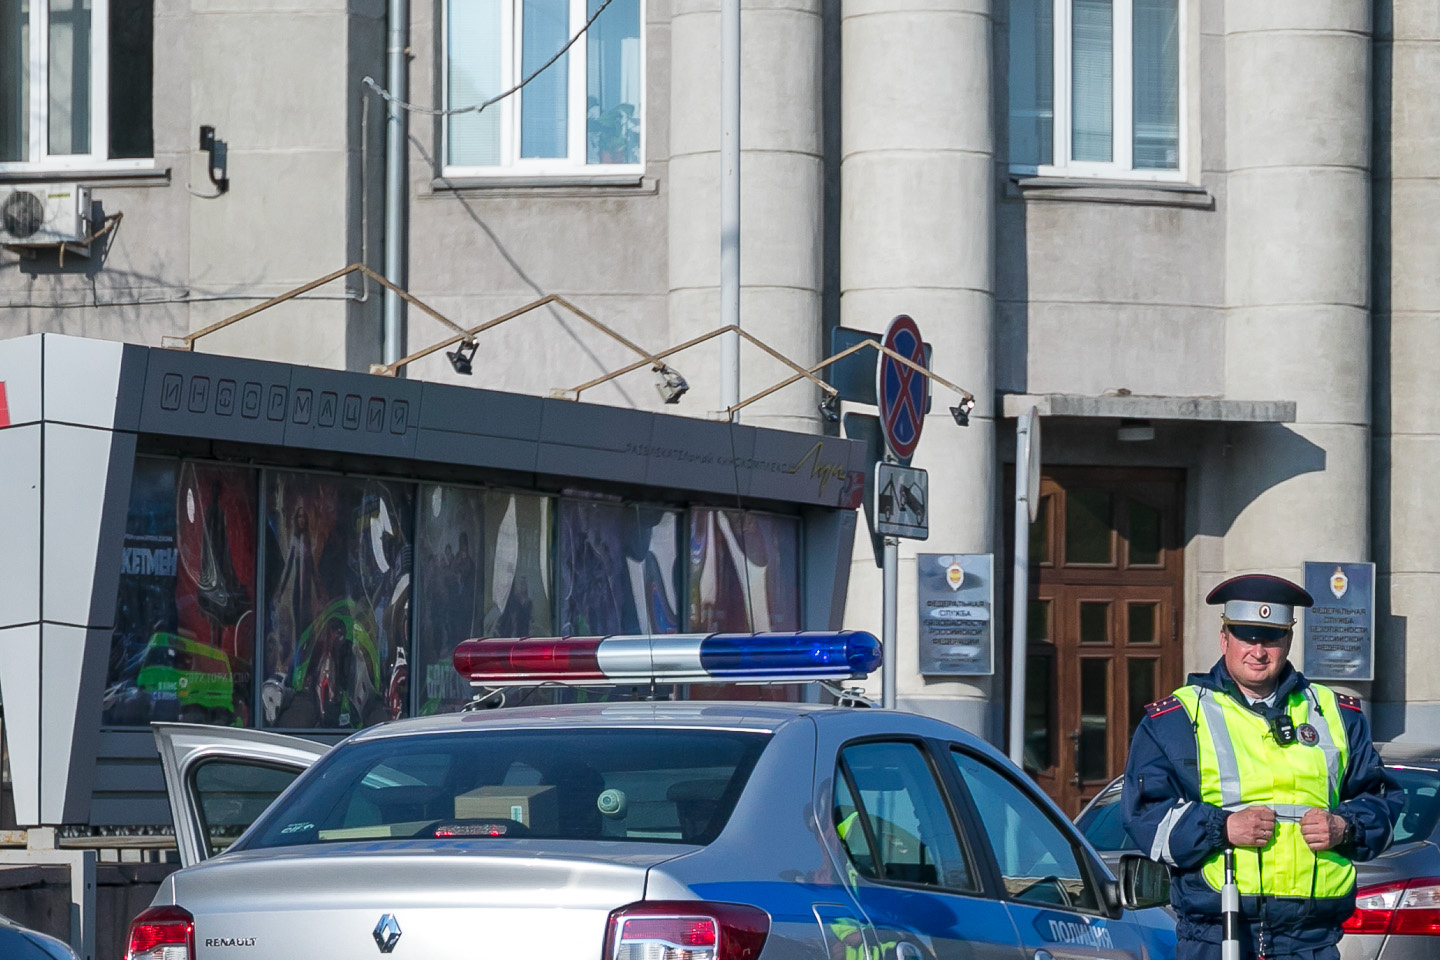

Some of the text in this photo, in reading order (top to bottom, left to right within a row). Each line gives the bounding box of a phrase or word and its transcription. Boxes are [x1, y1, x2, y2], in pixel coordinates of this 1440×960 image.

[163, 378, 408, 431] ИНФОРМАЦИЯ
[939, 609, 972, 617] СЛУЖБА
[205, 937, 257, 948] RENAULT
[1048, 919, 1114, 952] ПОЛИЦИЯ
